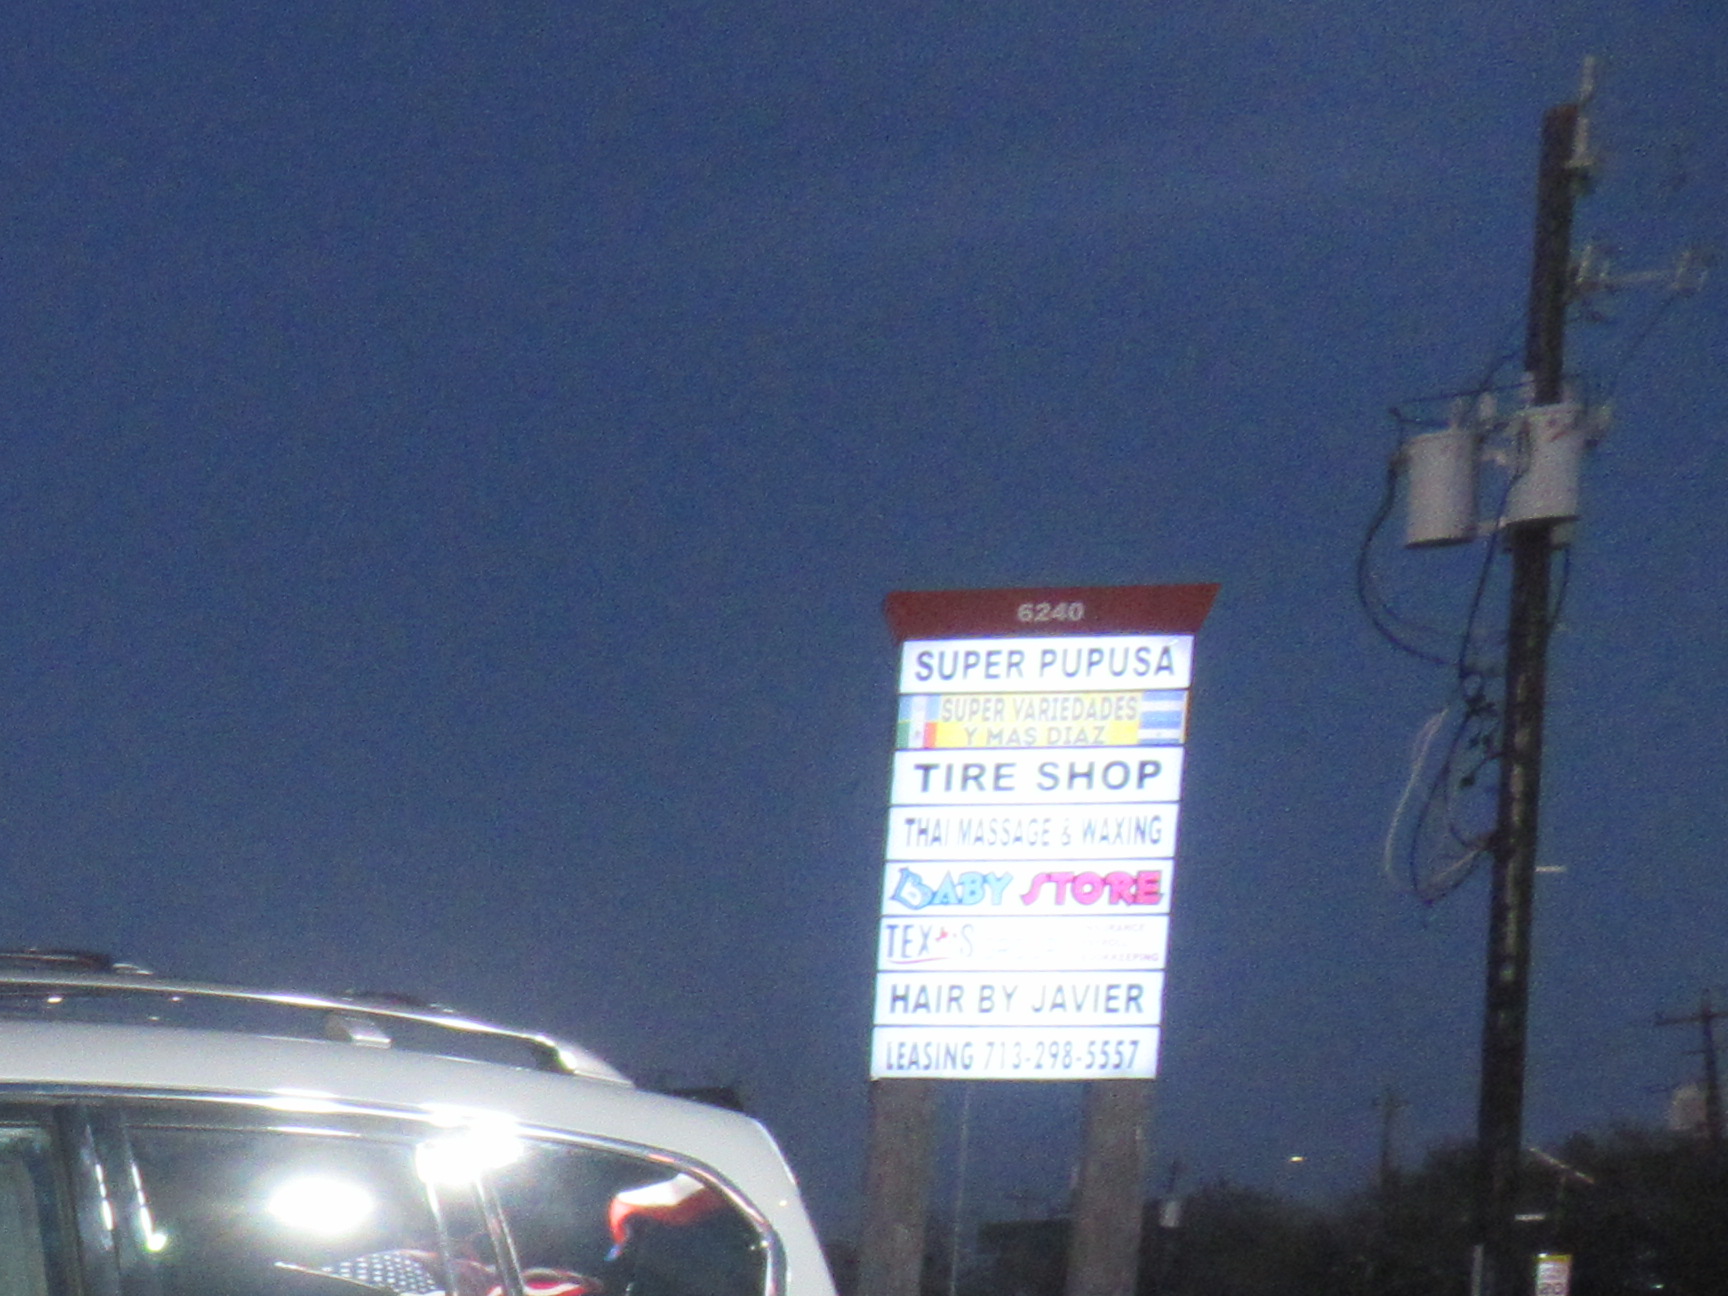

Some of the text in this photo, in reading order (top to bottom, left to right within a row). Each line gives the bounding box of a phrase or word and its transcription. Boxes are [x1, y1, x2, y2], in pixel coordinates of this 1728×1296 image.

[1018, 602, 1084, 622] 6240
[915, 646, 1174, 682] SUPER PUPUSA
[941, 695, 1137, 722] SUPER VARIEDADES
[964, 724, 1106, 745] Y MAS DIAZ
[914, 760, 1162, 793] TIRE SHOP
[905, 818, 948, 847] THAI
[959, 818, 1051, 847] MASSAGE
[1081, 815, 1162, 845] WAXING
[890, 866, 1164, 910] BABY STORE
[885, 923, 975, 958] TEXS
[889, 983, 1145, 1014] HAIR BY JAVIER
[887, 1042, 974, 1071] LEASING
